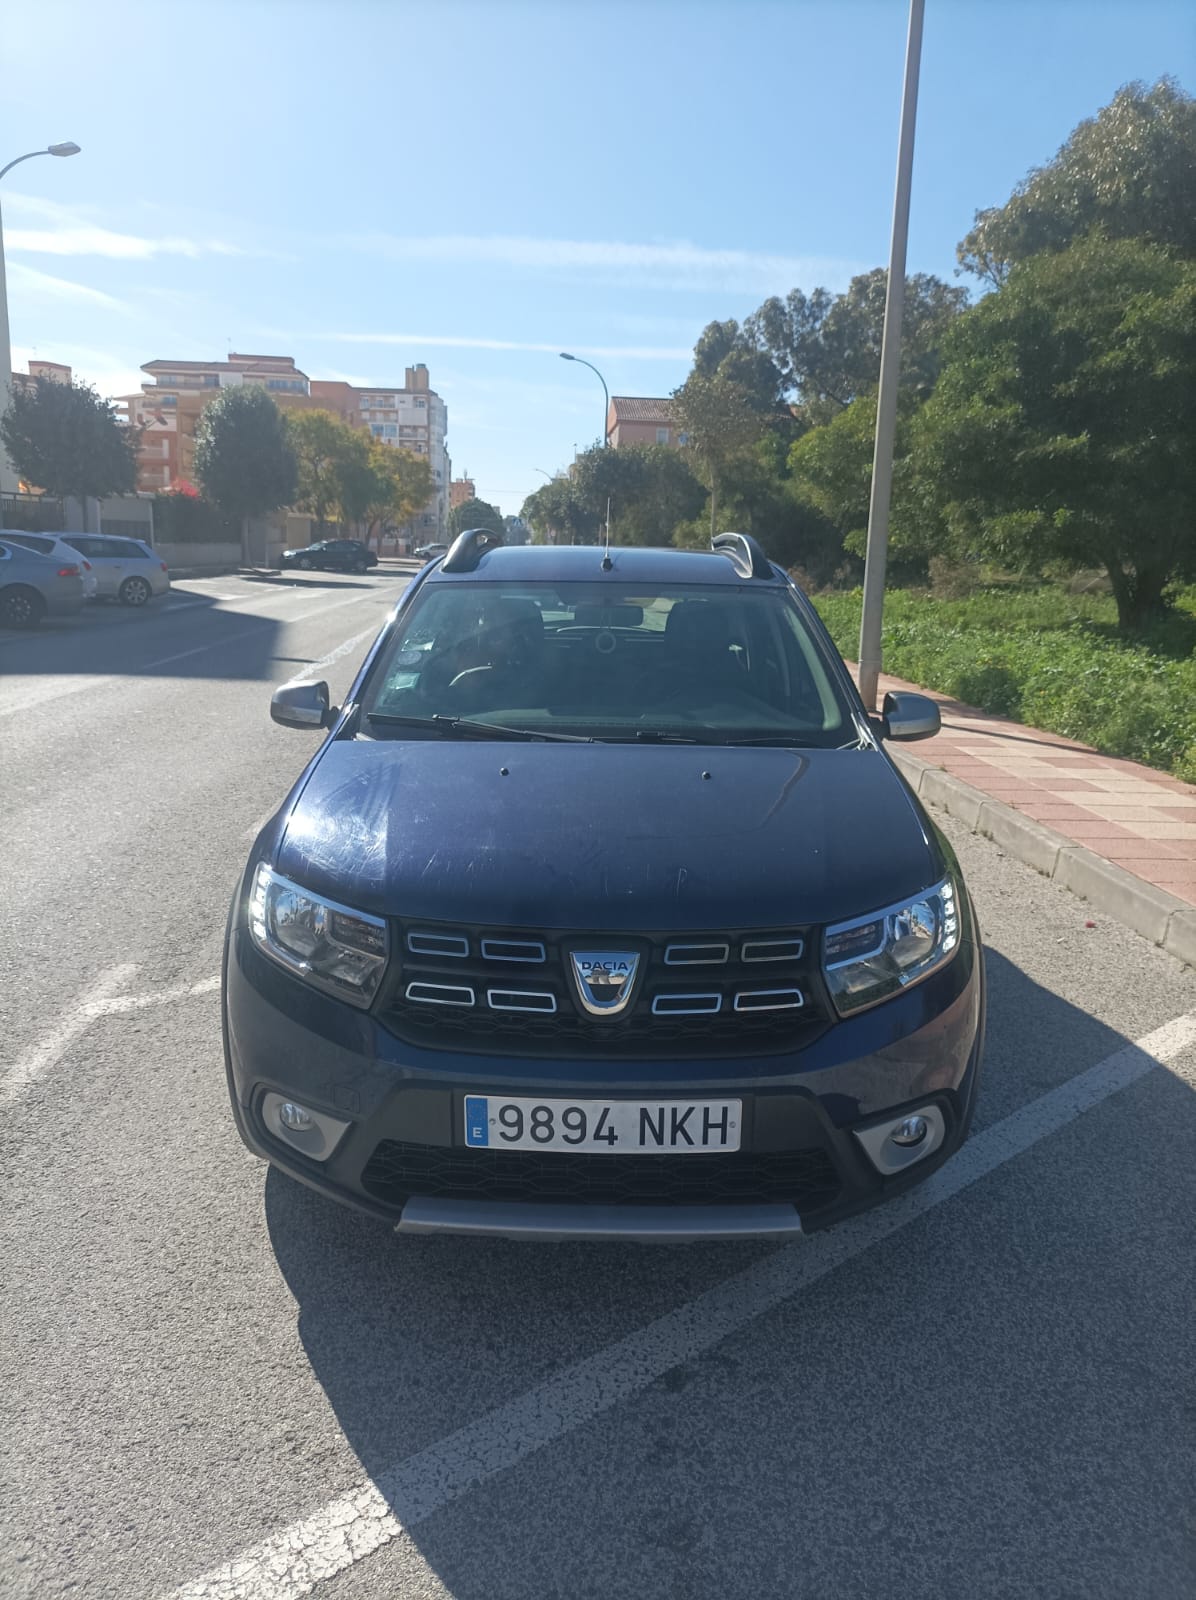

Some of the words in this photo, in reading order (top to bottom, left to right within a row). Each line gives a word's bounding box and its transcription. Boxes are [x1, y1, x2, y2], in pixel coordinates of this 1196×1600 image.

[581, 961, 628, 970] DACIA
[499, 1104, 618, 1146] 9894
[639, 1106, 729, 1146] NKH
[473, 1127, 482, 1138] E
